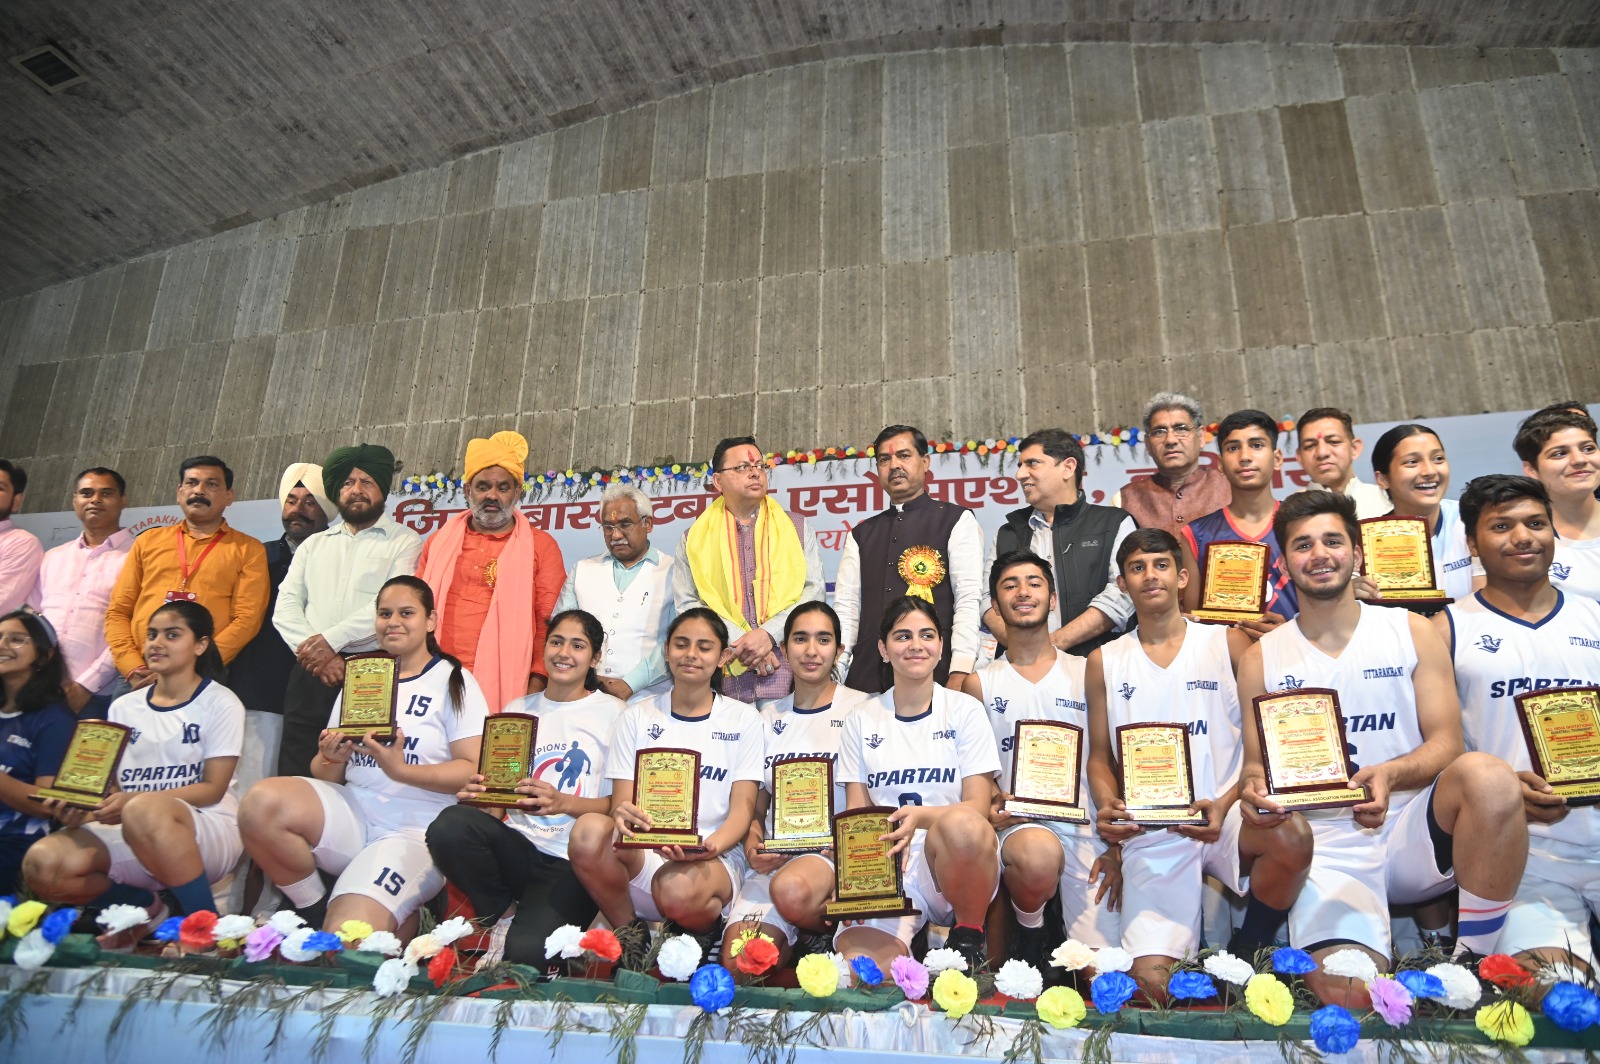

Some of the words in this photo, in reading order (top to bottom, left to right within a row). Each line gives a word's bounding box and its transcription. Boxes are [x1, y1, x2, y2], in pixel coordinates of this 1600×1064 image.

[405, 694, 432, 717] 15
[181, 722, 201, 744] 10
[534, 742, 567, 757] PIONS
[121, 761, 202, 782] SPARTAN
[867, 767, 956, 789] SPARTAN
[373, 867, 406, 896] 15
